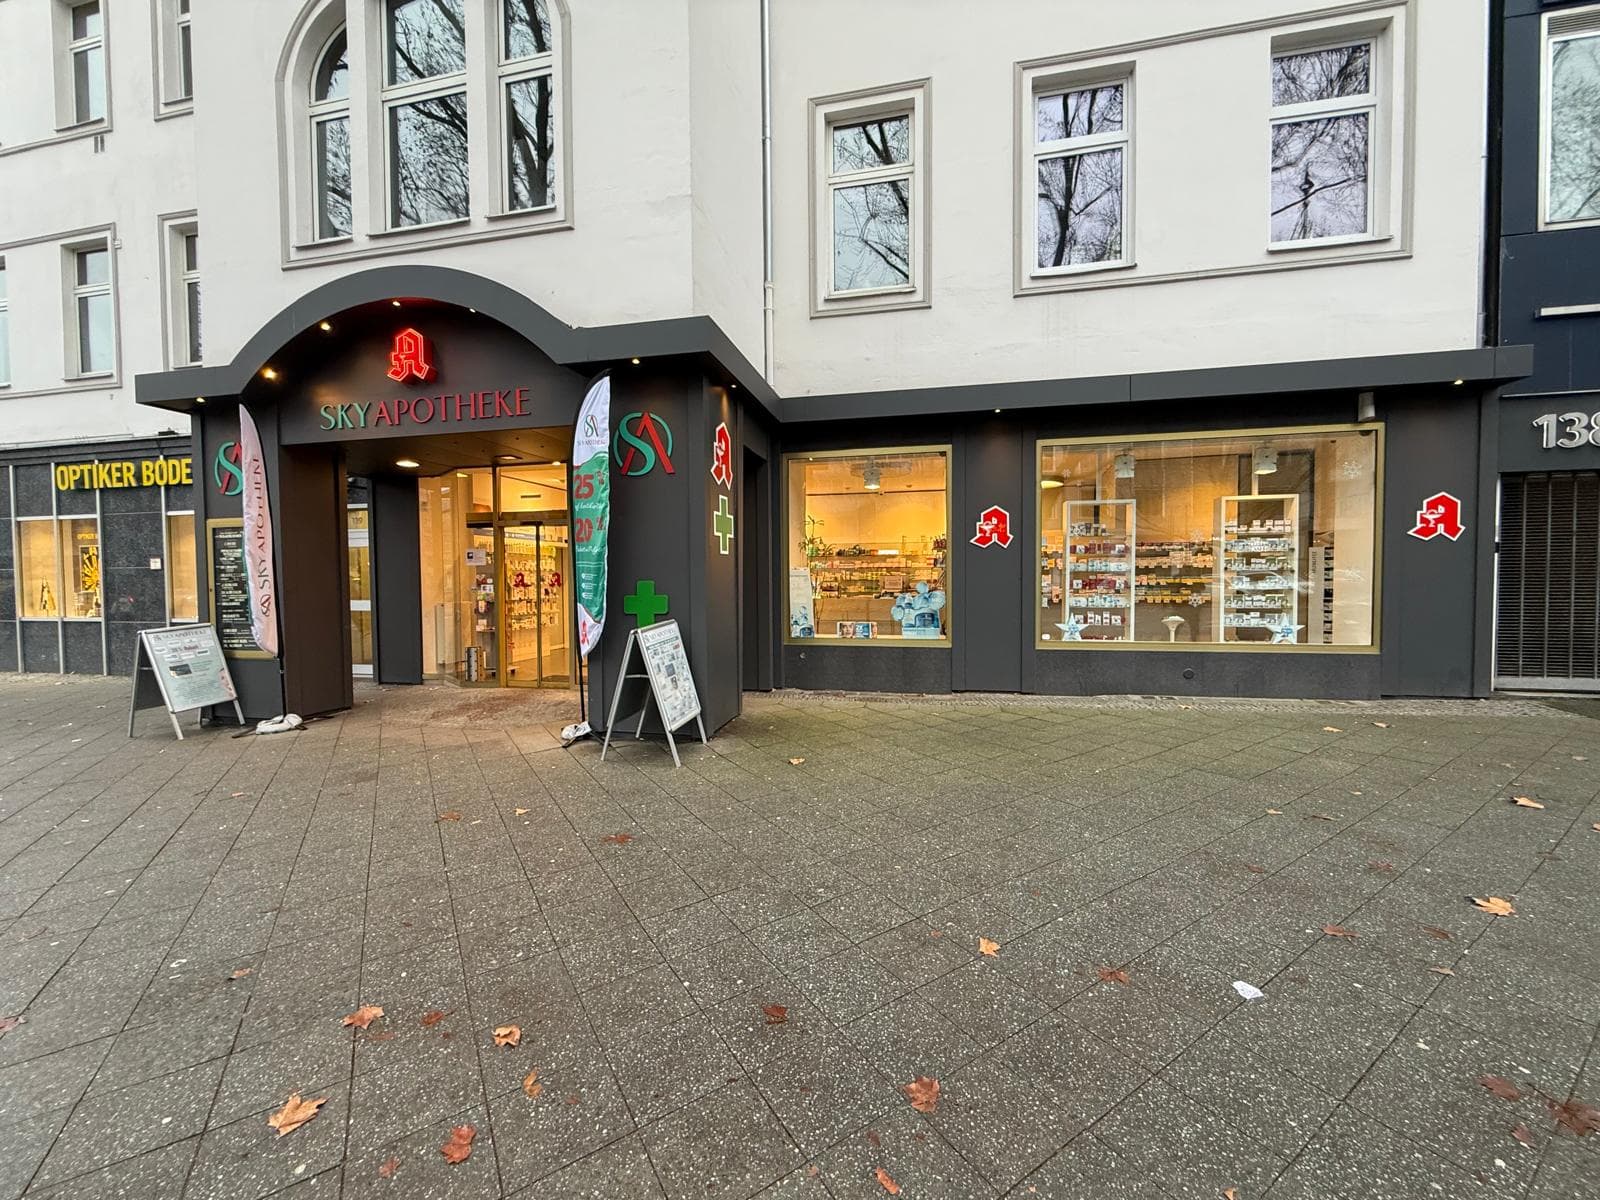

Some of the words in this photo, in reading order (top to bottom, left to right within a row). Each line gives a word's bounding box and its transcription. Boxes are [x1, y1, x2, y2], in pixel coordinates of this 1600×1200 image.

[56, 463, 137, 491] OPTIKER
[142, 458, 193, 487] BODE
[575, 518, 593, 543] 20
[258, 557, 271, 590] SKY
